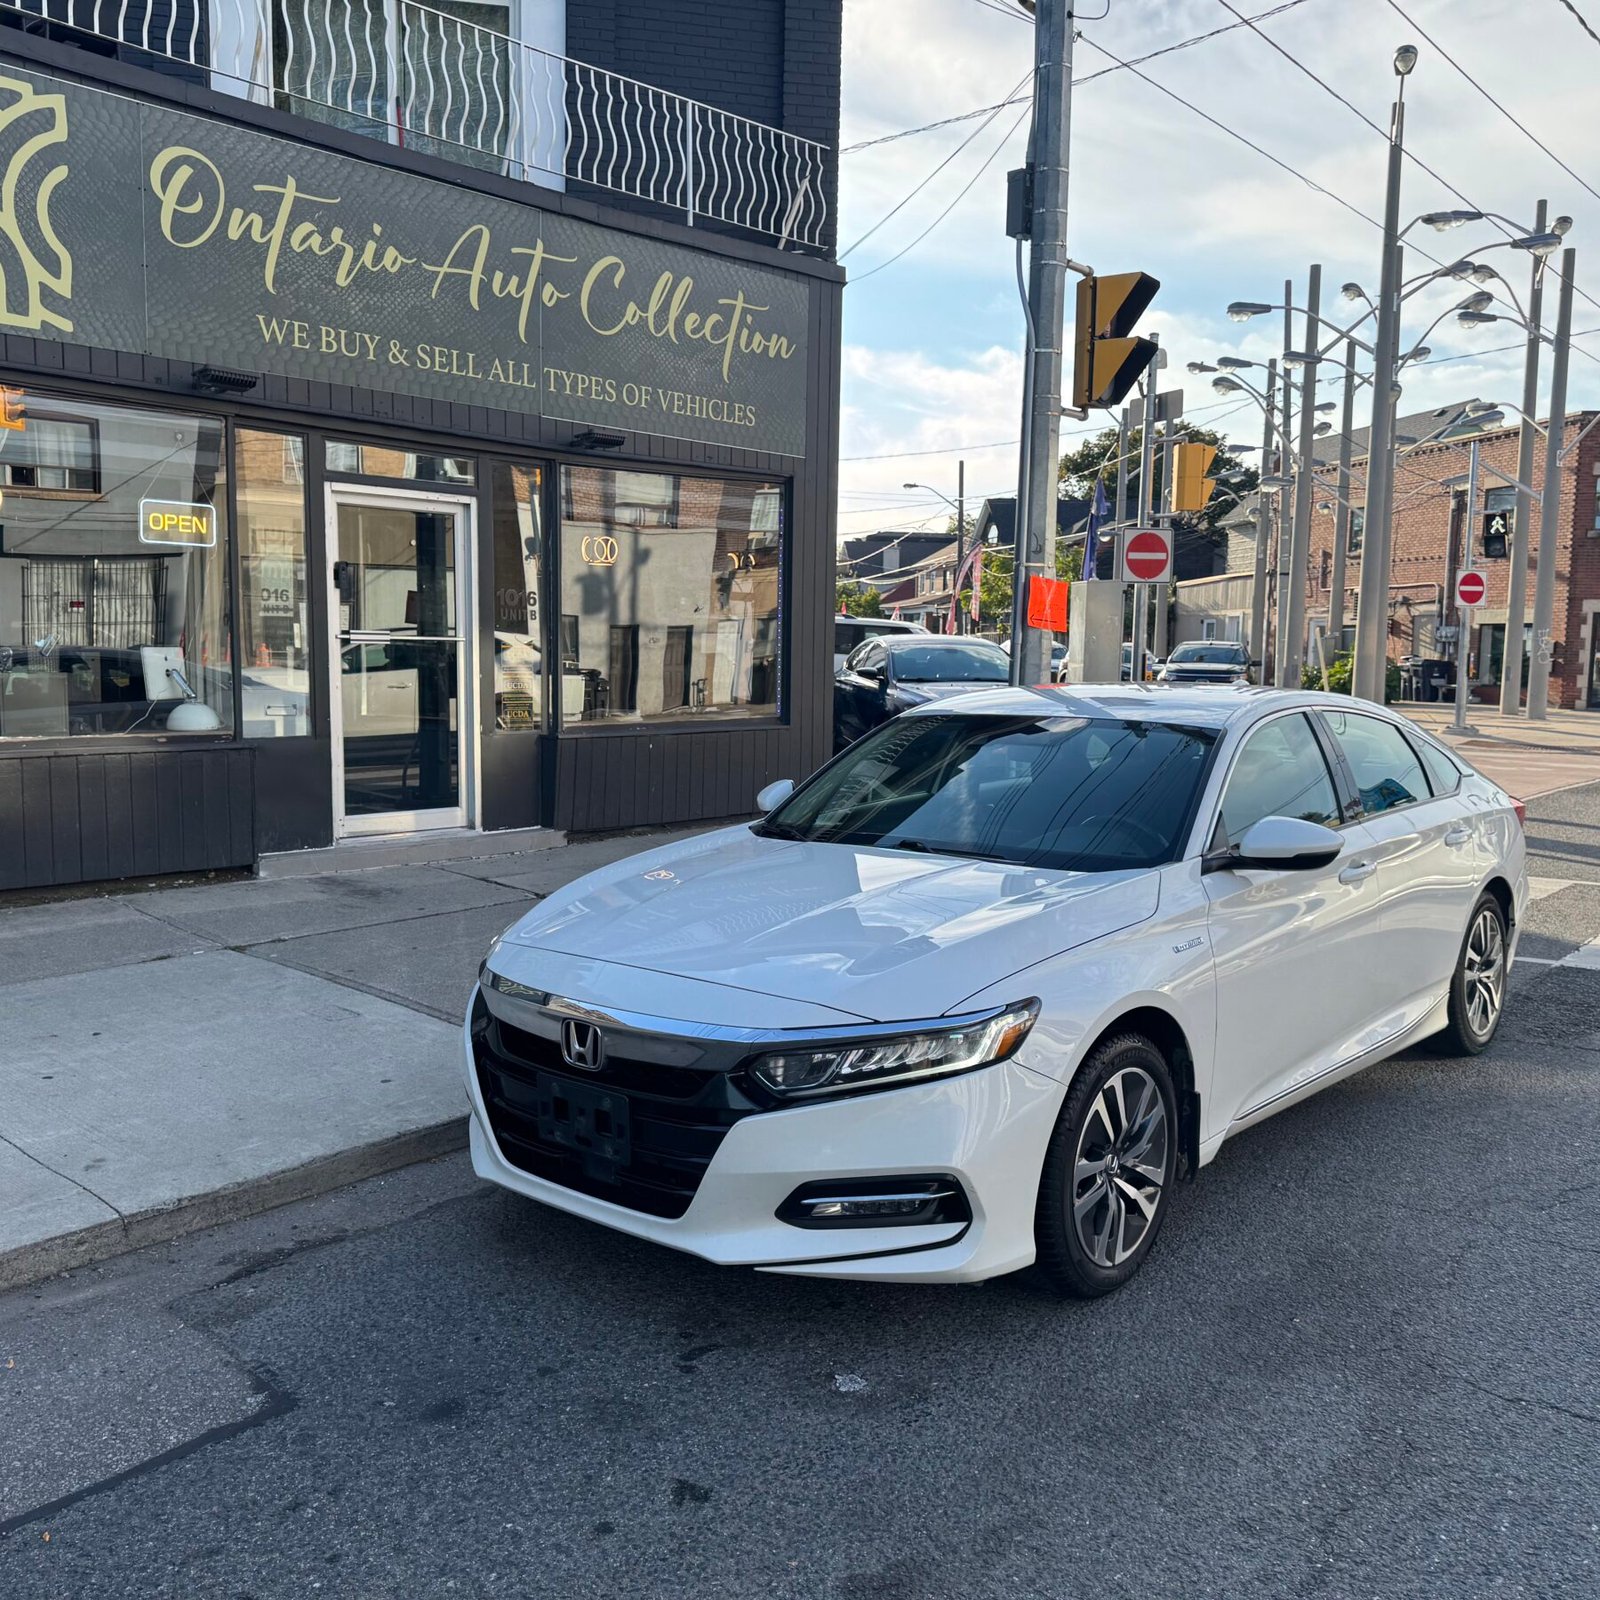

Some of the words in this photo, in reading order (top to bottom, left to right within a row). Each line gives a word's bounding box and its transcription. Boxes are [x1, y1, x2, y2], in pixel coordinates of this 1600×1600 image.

[150, 146, 417, 295] Ontario
[421, 223, 578, 344] Auto
[580, 255, 797, 384] Collection
[256, 314, 311, 349] WE
[319, 325, 381, 361] BUY
[388, 339, 410, 367] &
[416, 343, 483, 379] SELL
[487, 357, 537, 388] ALL
[543, 367, 617, 402] TYPES
[622, 383, 653, 408] OF
[656, 388, 757, 427] VEHICLES
[148, 512, 207, 535] OPEN
[496, 588, 538, 607] 1016
[500, 608, 528, 620] UNIT
[530, 610, 538, 621] B
[507, 710, 530, 719] UCDA
